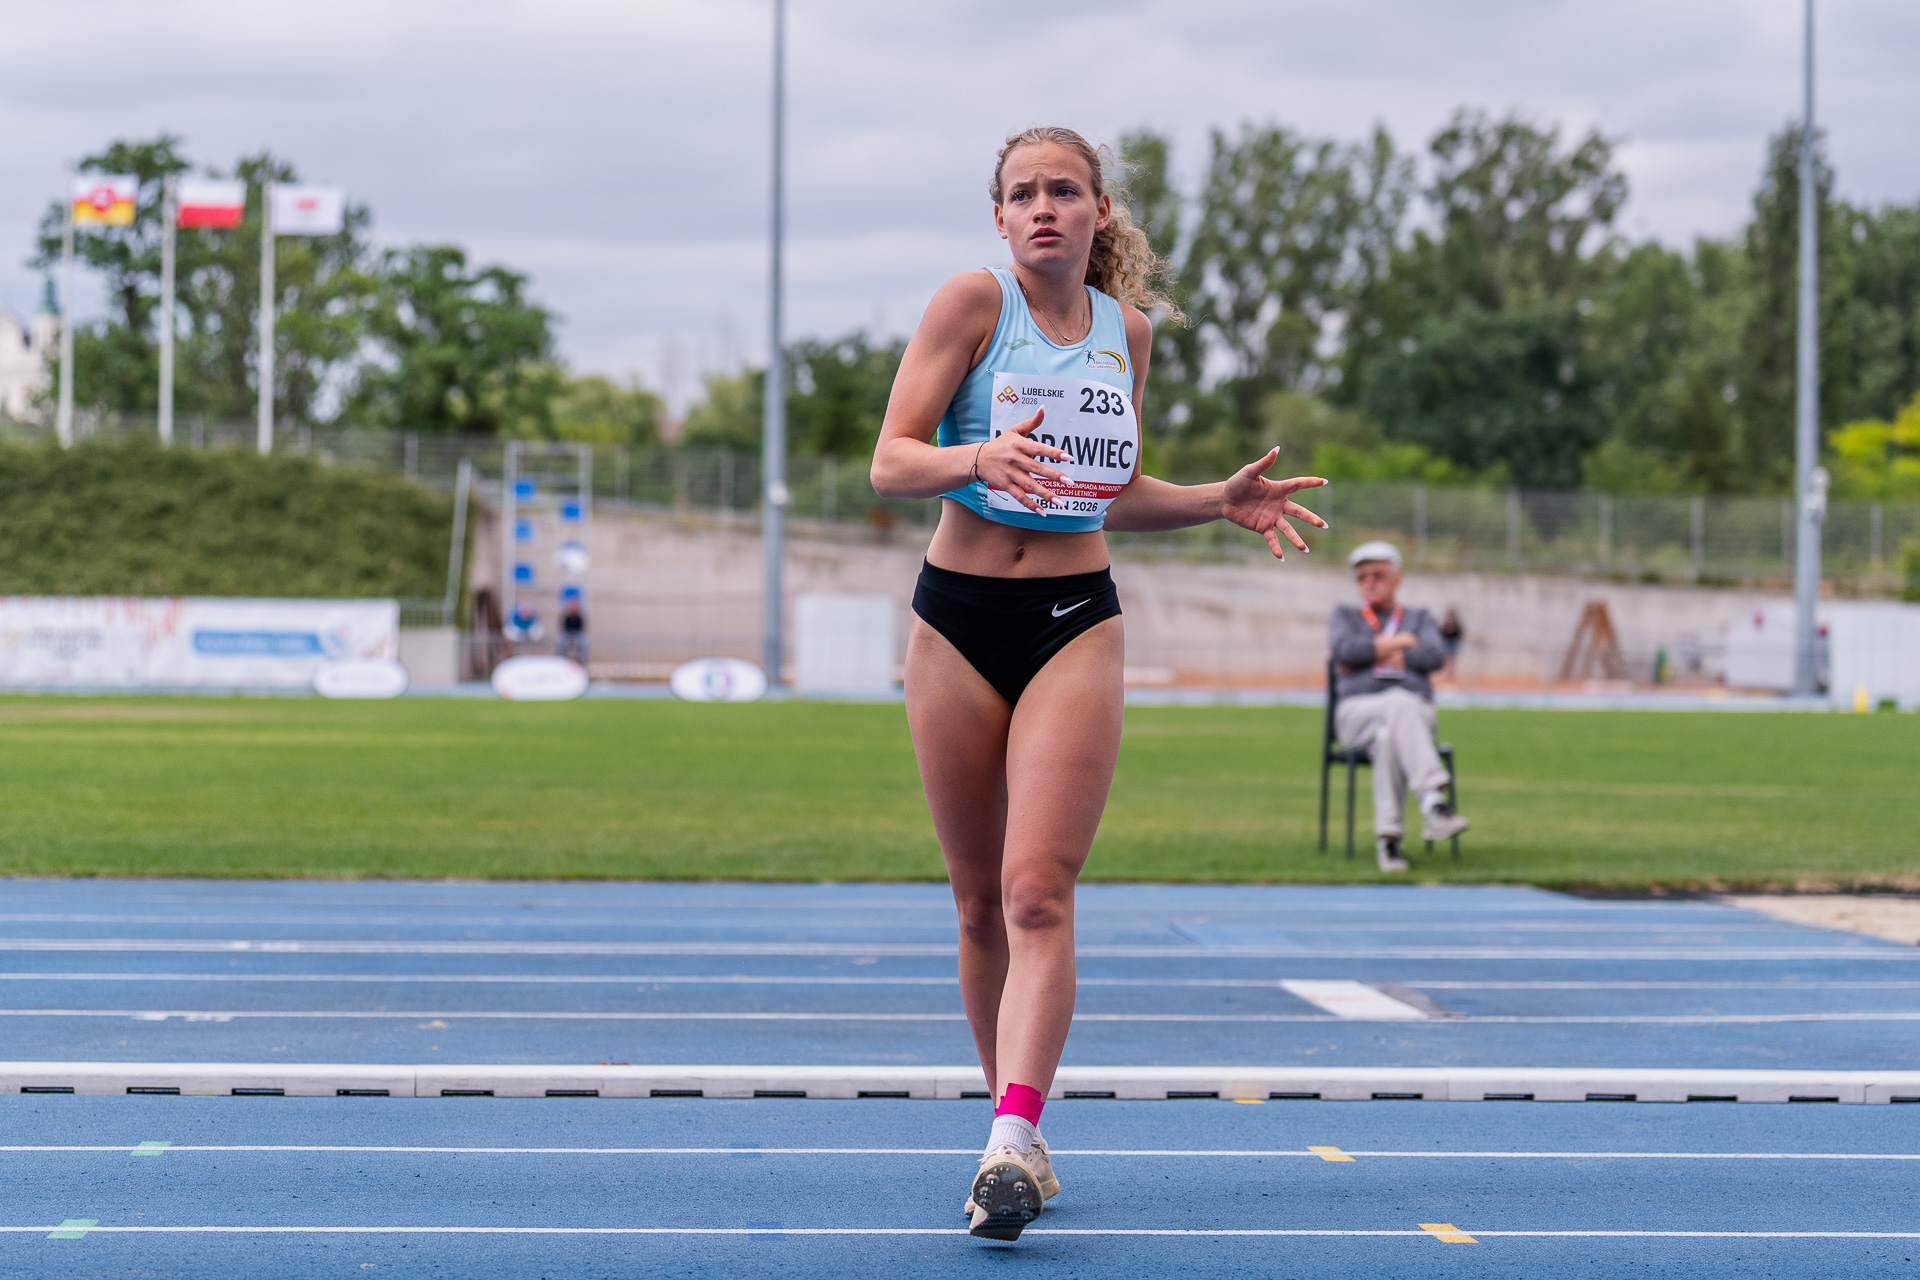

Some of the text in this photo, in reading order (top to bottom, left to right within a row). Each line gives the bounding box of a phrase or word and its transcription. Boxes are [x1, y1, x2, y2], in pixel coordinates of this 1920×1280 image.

[1022, 387, 1065, 398] LUBELSKIE
[1021, 397, 1038, 405] 2026
[1079, 387, 1125, 416] 233
[995, 430, 1134, 469] RAWIEC
[1067, 482, 1098, 491] OLIMPIADA
[1049, 488, 1098, 498] ORTACH LETNICH
[1024, 498, 1099, 512] UBLIN 2026
